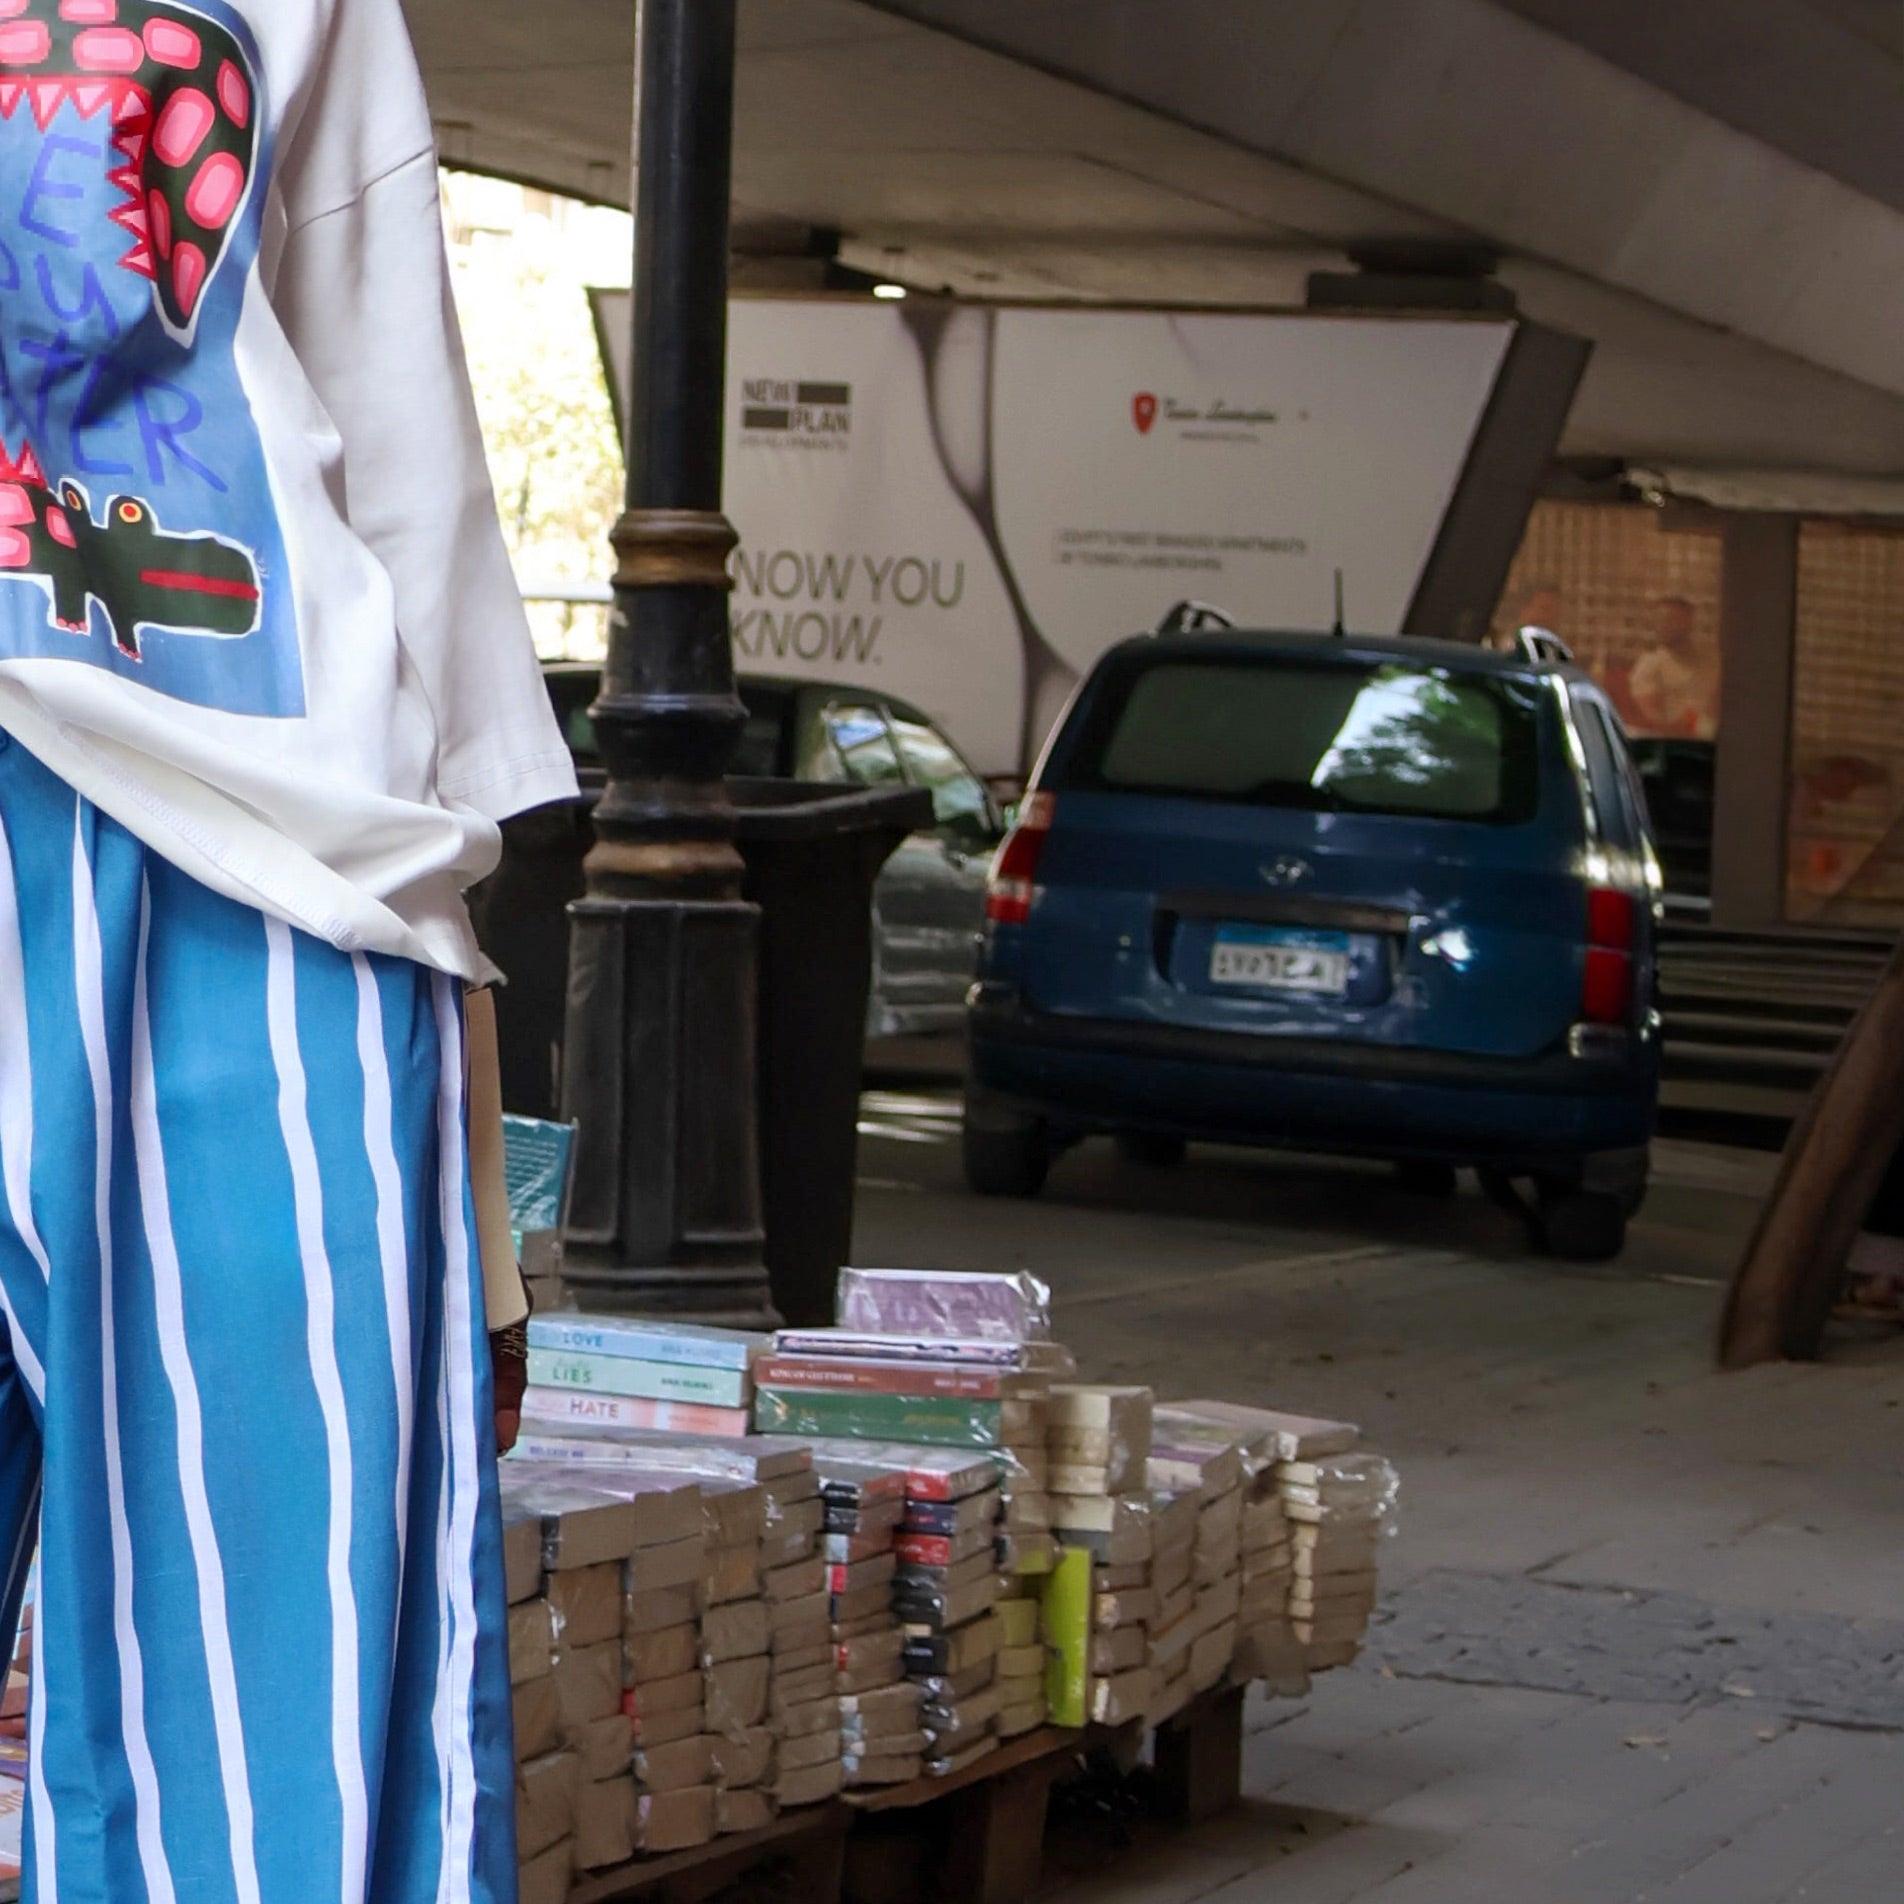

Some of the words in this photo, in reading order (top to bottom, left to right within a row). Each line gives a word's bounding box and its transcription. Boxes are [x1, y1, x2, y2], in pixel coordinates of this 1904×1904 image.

[742, 378, 791, 402] NEW
[795, 409, 850, 433] PLAN
[732, 549, 855, 601] NOW
[862, 554, 965, 609] YOU
[732, 609, 884, 666] KNOW.
[562, 1331, 604, 1347] LOVE
[552, 1367, 593, 1385] LIES
[569, 1397, 620, 1419] HATE
